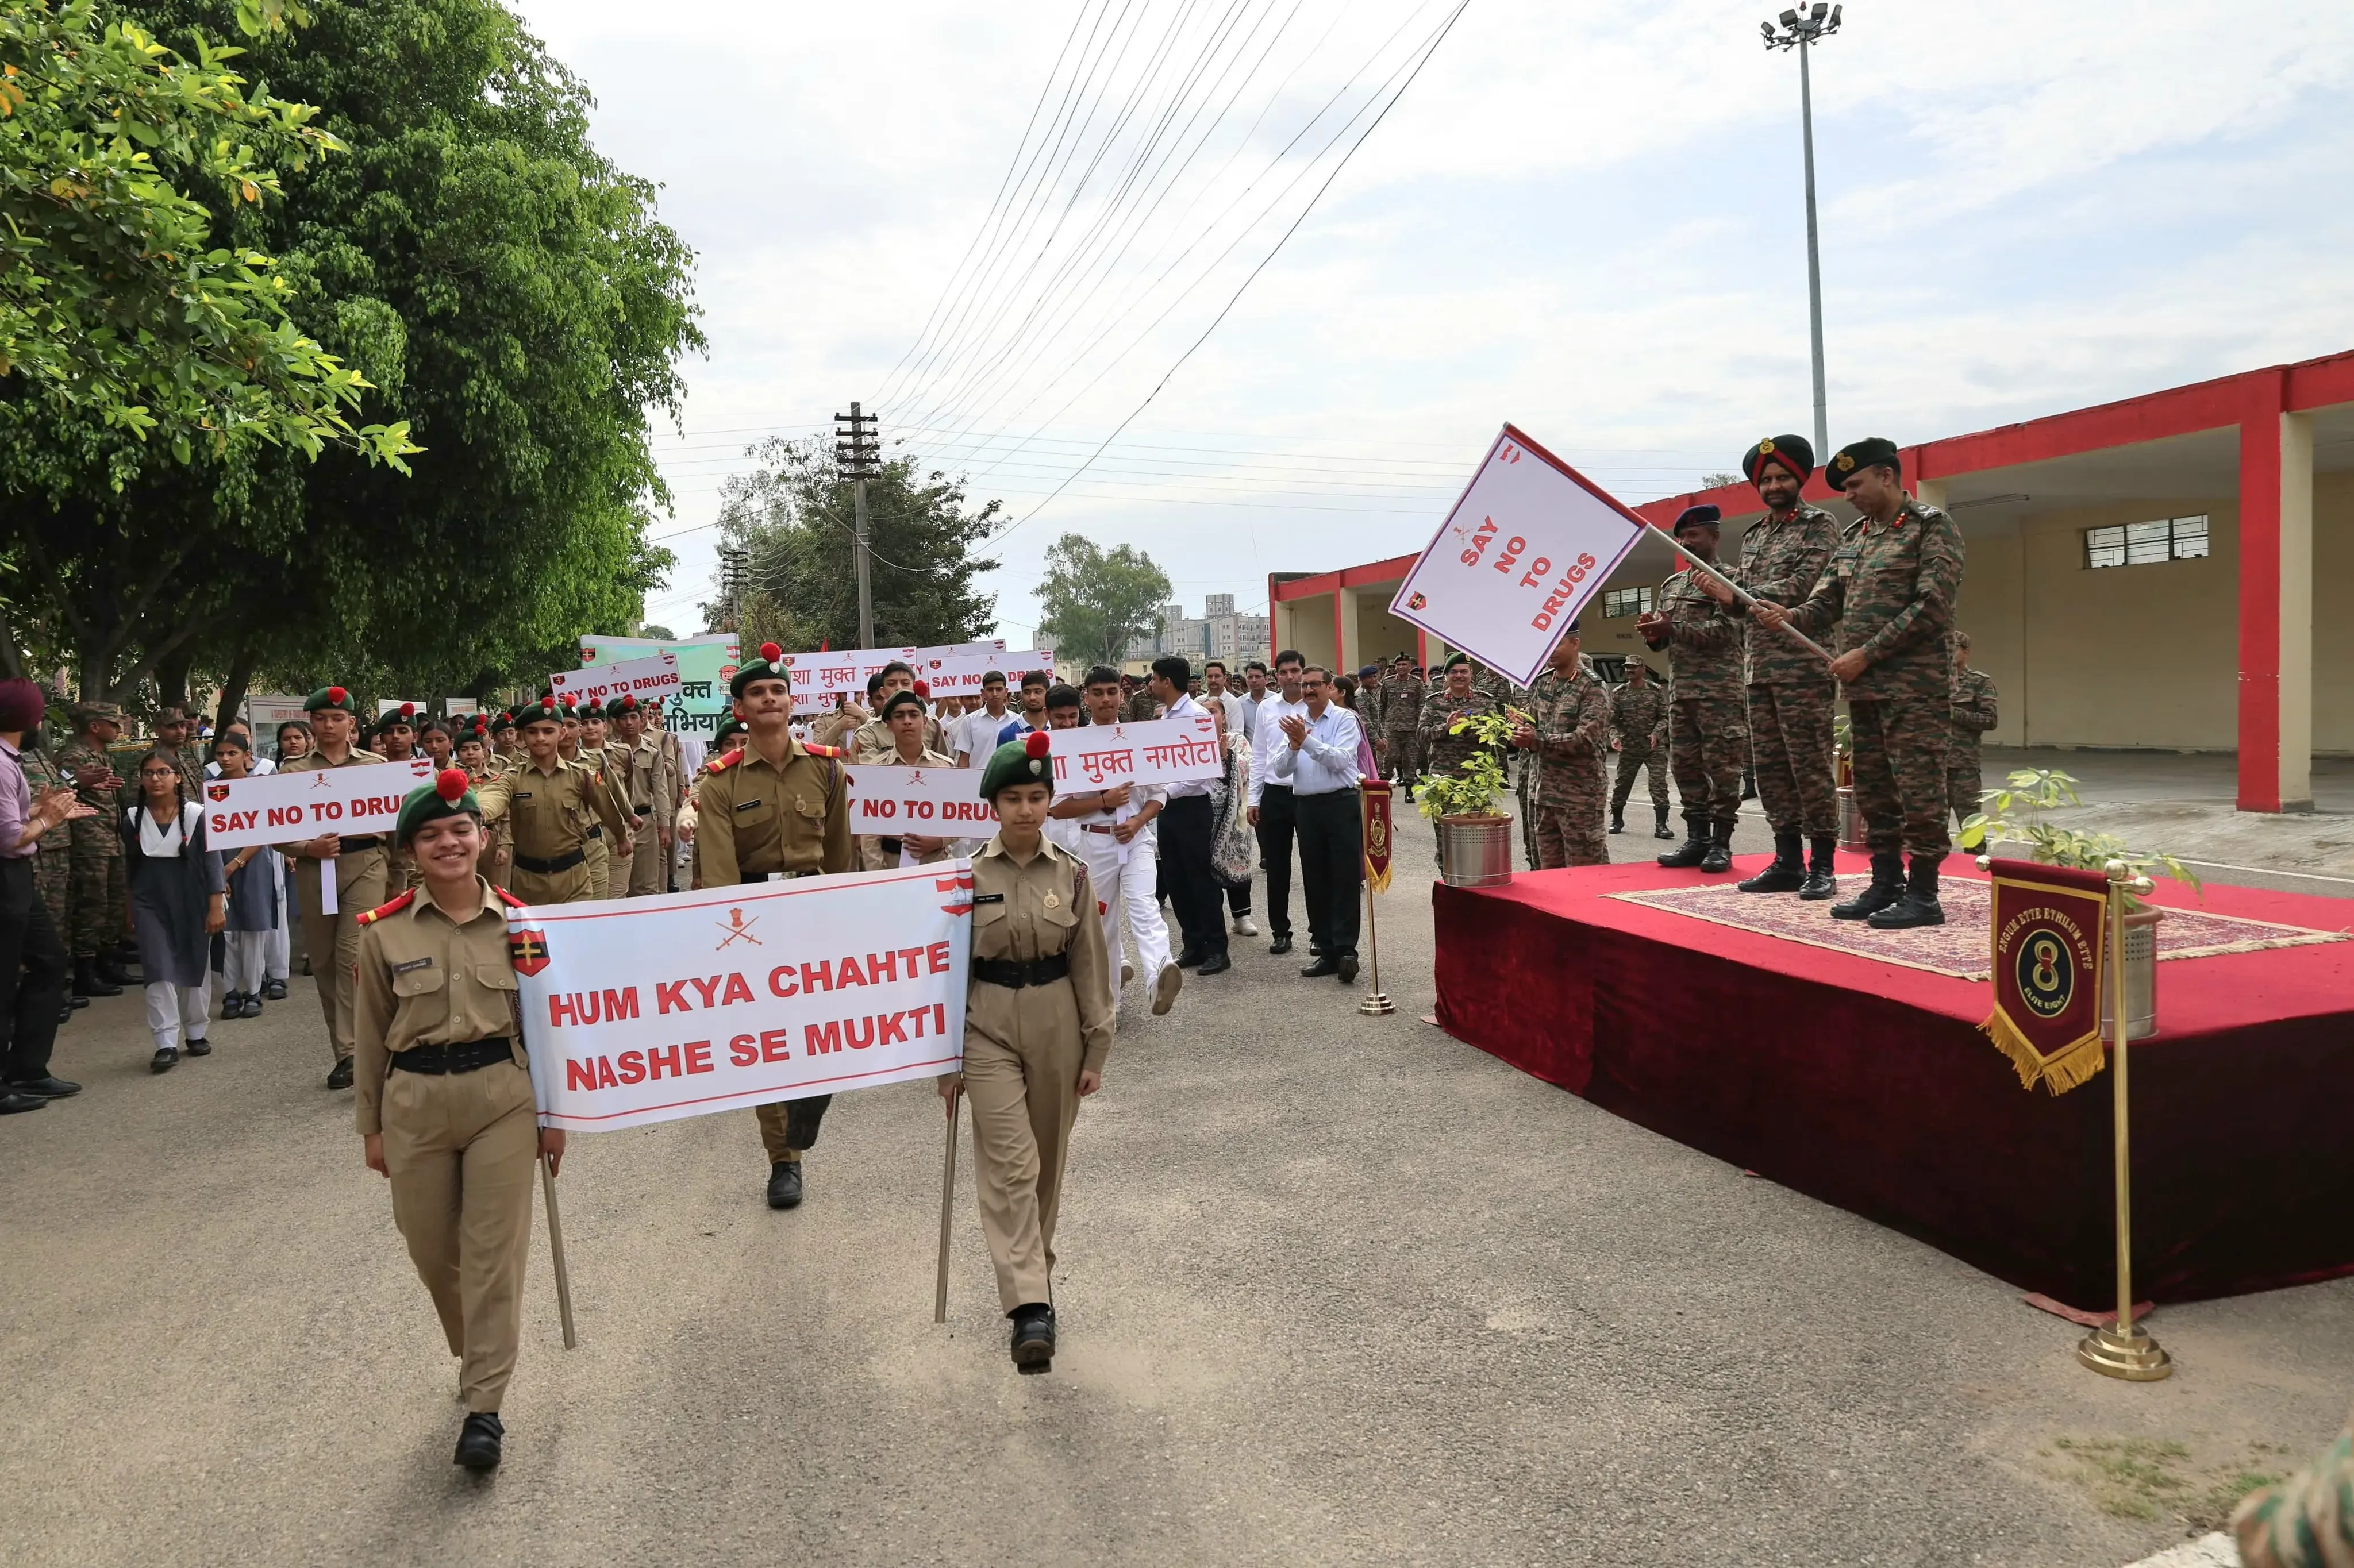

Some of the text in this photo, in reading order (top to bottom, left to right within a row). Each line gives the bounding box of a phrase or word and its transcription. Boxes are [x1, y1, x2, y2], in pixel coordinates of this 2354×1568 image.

[1460, 515, 1498, 567] SAY
[1494, 536, 1526, 574] NO
[1520, 557, 1551, 588] TO
[1531, 553, 1595, 632] DRUGS
[588, 685, 607, 698] NO
[611, 681, 629, 693] TO
[633, 673, 678, 690] DRUGS
[789, 669, 811, 685] शा
[820, 667, 856, 688] मुक्त
[932, 669, 1053, 688] SAY NO DRS
[1079, 749, 1133, 784] मुक्त
[1143, 735, 1217, 770] नगरोटा
[211, 794, 407, 833] SAY NO TO DRU
[863, 799, 896, 818] NO
[903, 800, 934, 819] TO
[942, 802, 1000, 822] DRU
[2017, 908, 2041, 924] ETTE
[2077, 940, 2093, 969] ETTE
[549, 940, 950, 1027] HUM KYA CHAHTE
[2024, 987, 2066, 1009] ELITE EIGHT
[567, 1003, 945, 1091] NASHE SE MUKTI
